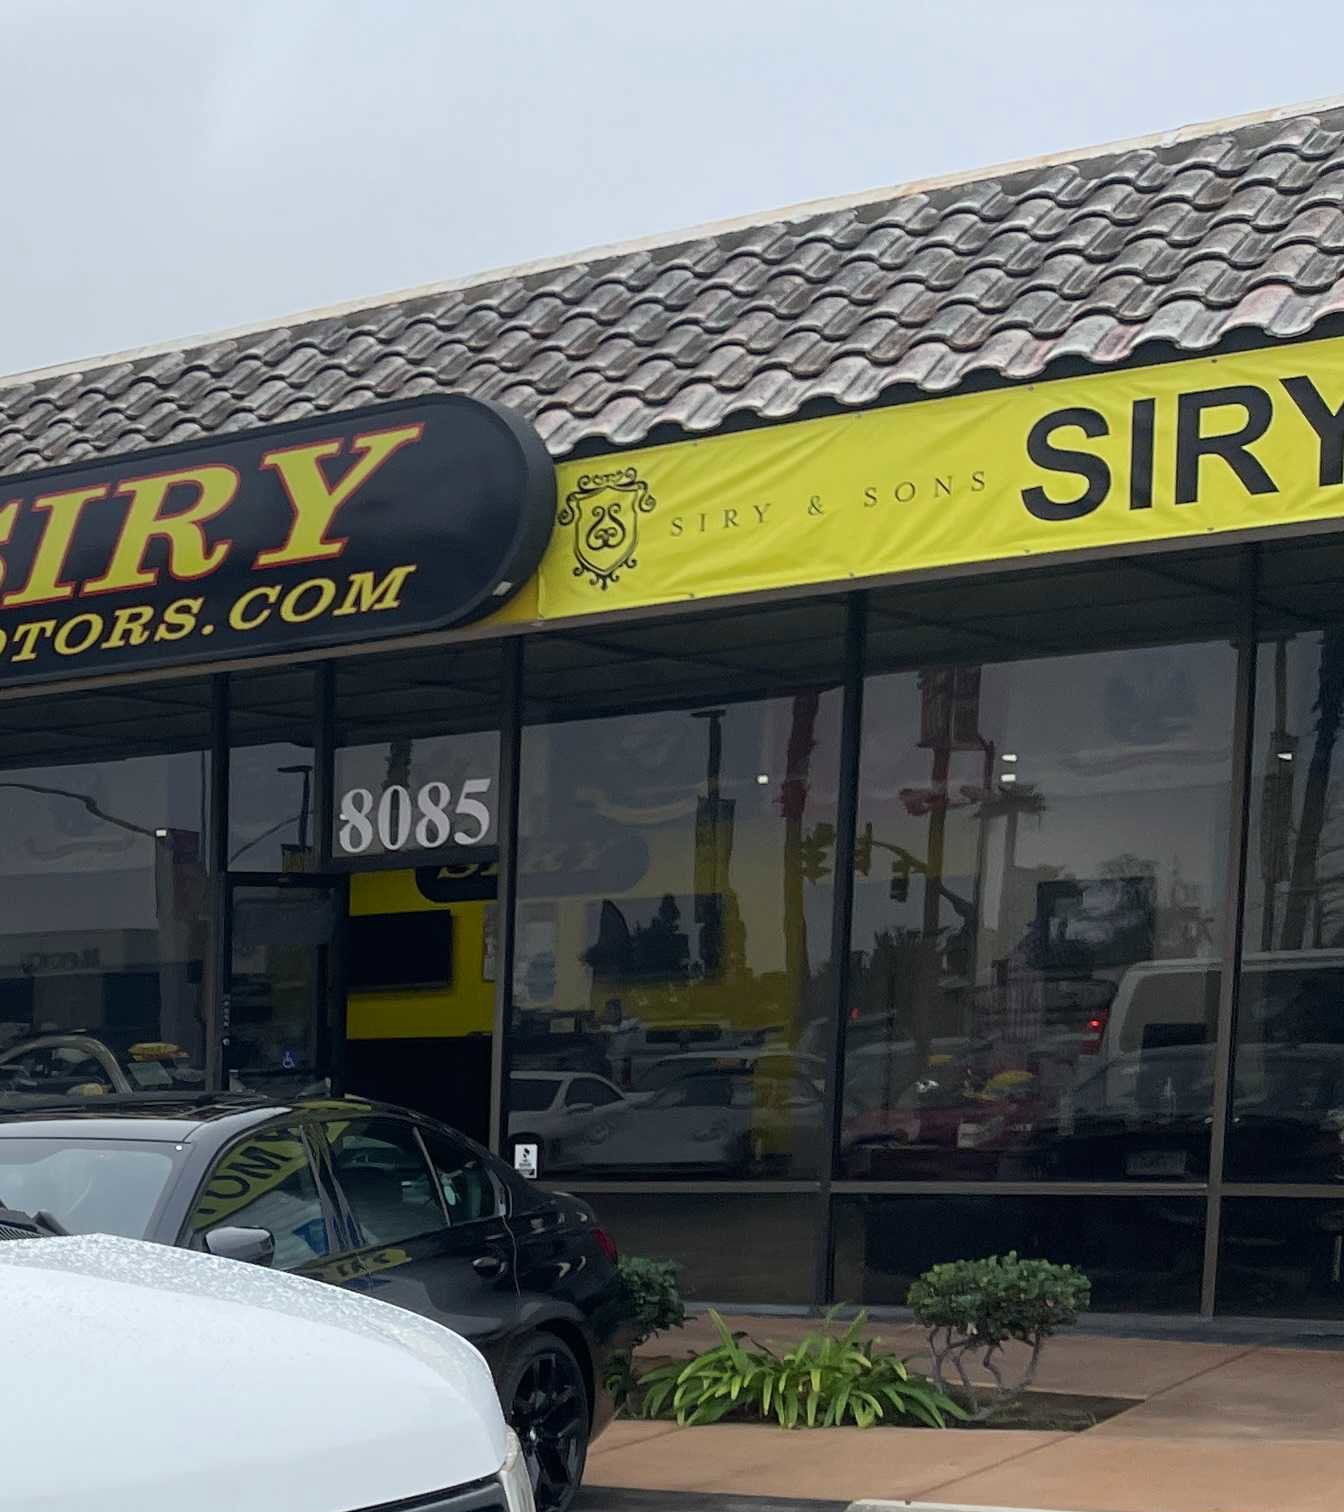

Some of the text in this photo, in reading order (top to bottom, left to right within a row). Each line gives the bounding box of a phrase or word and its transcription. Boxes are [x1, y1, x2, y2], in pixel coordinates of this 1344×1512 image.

[1021, 375, 1344, 521] SIRY
[670, 470, 986, 536] SIRY & SONS
[337, 777, 492, 853] 8085
